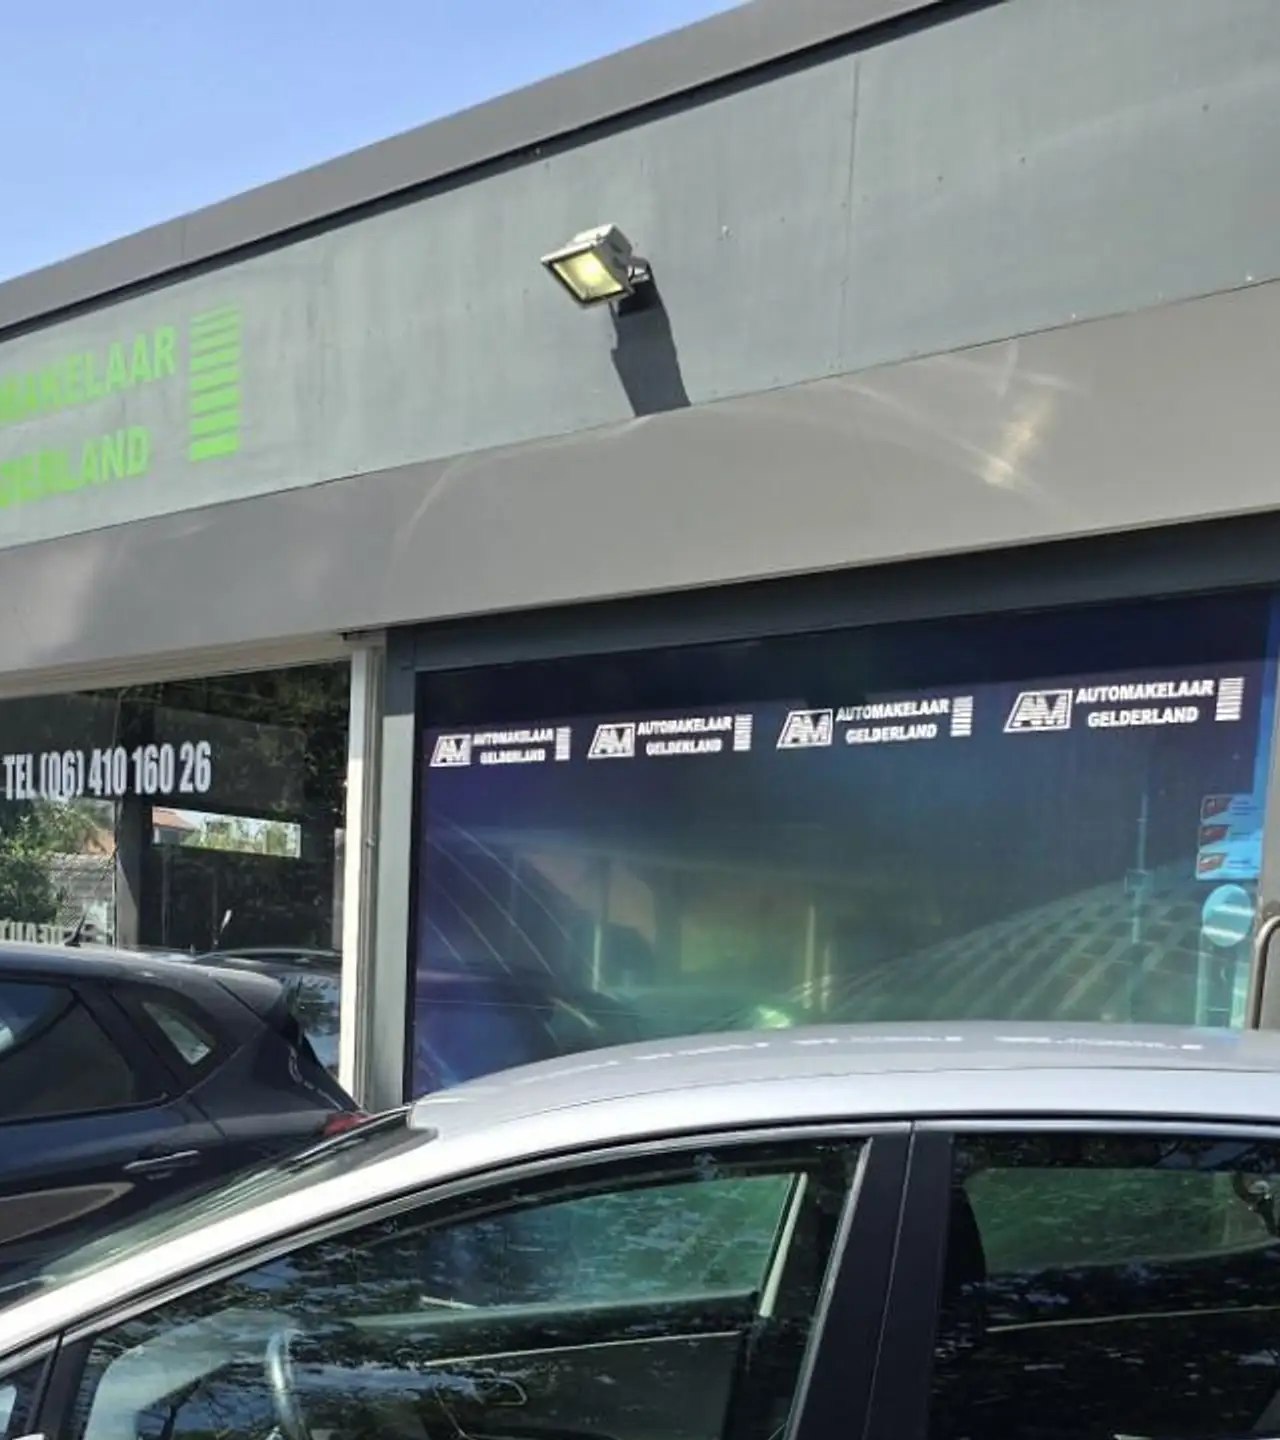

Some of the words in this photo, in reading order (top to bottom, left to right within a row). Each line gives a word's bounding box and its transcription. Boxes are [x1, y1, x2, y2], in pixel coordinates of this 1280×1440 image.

[1076, 679, 1215, 704] AUTOMAKELAAR
[835, 699, 950, 722] AUTOMAKELAAR
[1087, 706, 1199, 728] GELDERLAND
[637, 716, 733, 736] AUTOMAKELAAR
[845, 724, 937, 744] GELDERLAND
[646, 738, 722, 756] GELDERLAND
[3, 753, 37, 800] TEL
[39, 750, 85, 802] (06)
[88, 746, 128, 796] 410
[132, 743, 176, 795] 160
[179, 740, 212, 793] 26
